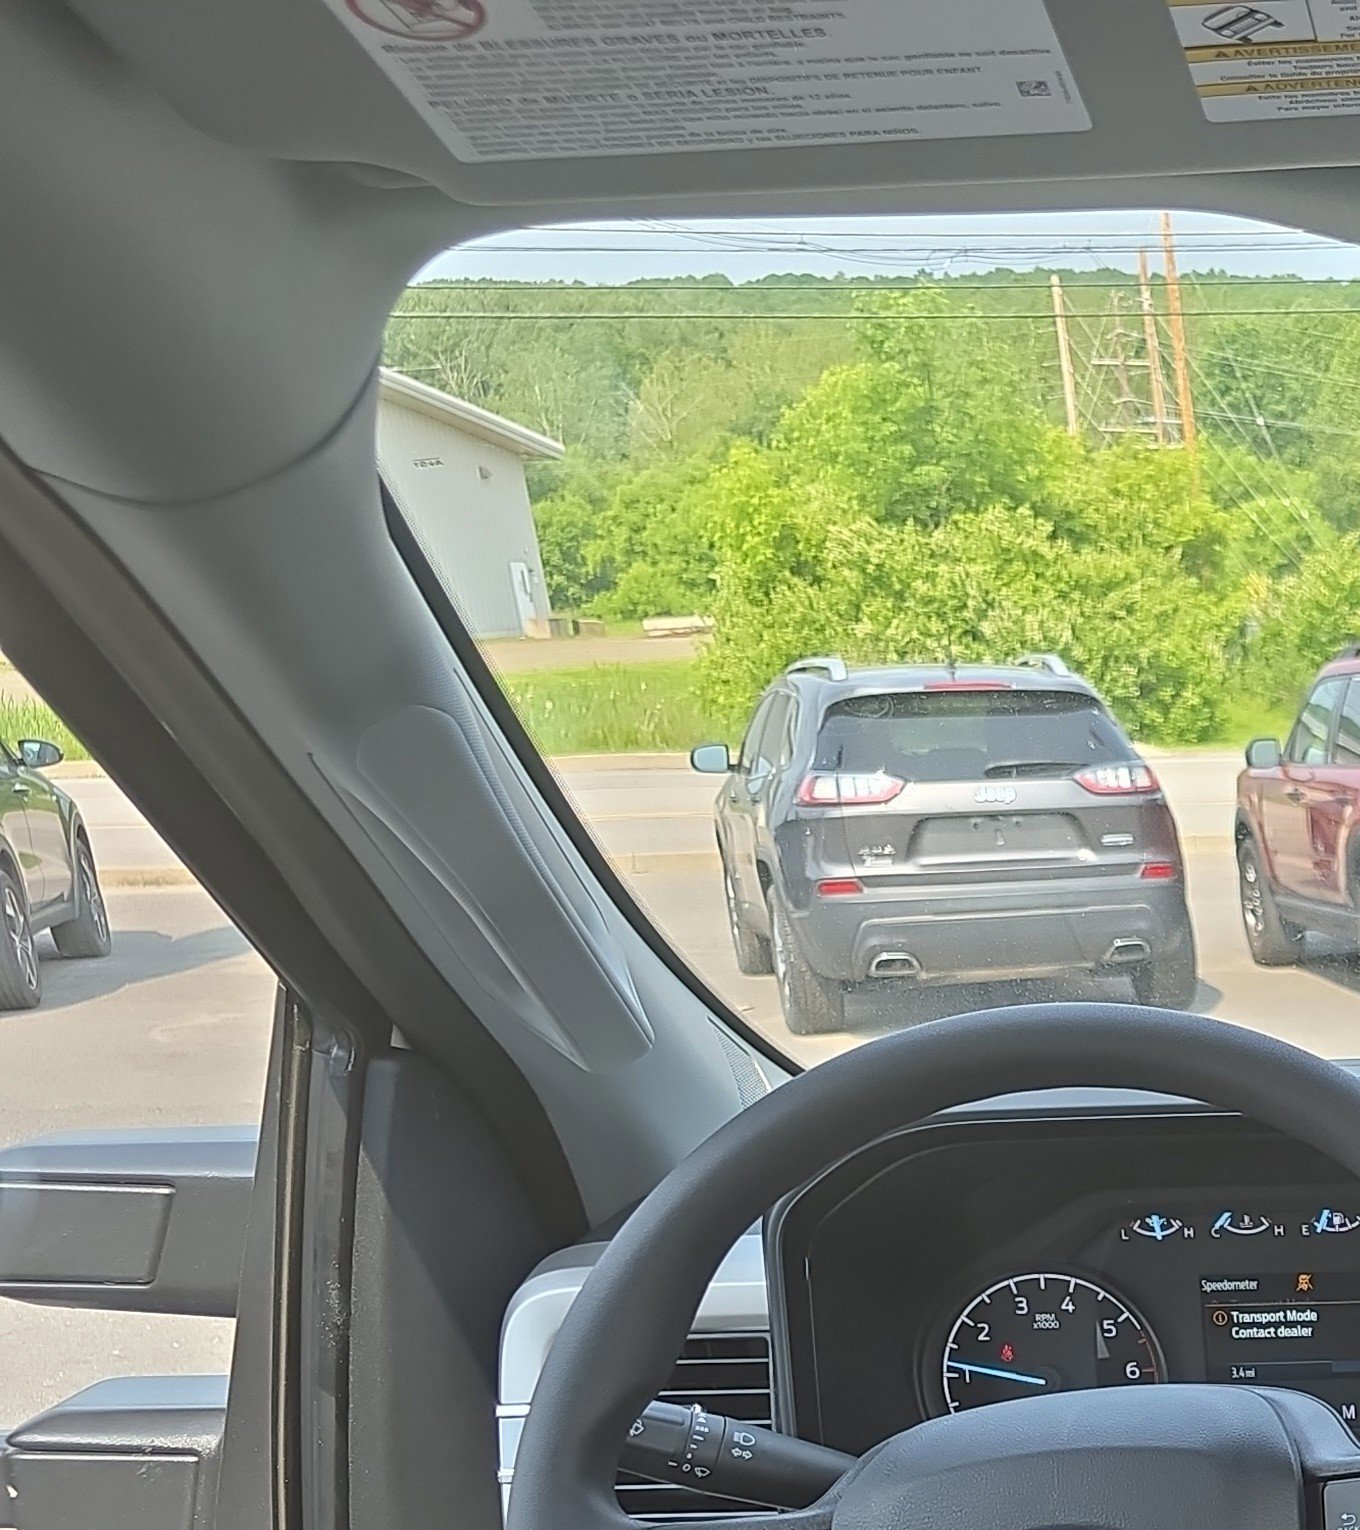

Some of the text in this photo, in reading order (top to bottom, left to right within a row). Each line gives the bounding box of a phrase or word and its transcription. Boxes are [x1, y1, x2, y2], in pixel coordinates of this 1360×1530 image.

[1121, 1229, 1130, 1241] L
[1184, 1227, 1195, 1239] H
[1210, 1227, 1221, 1238] C
[1274, 1225, 1285, 1236] H
[1301, 1225, 1310, 1236] E
[1201, 1279, 1259, 1293] Speedometer
[1015, 1297, 1028, 1314] 3
[1060, 1296, 1075, 1313] 4
[1035, 1313, 1055, 1322] RPM
[1231, 1309, 1318, 1325] Transport Mode
[977, 1323, 991, 1341] 2
[1102, 1320, 1117, 1337] 5
[1231, 1325, 1313, 1339] Contact dealer
[1125, 1361, 1140, 1379] 6
[1341, 1405, 1356, 1420] M
